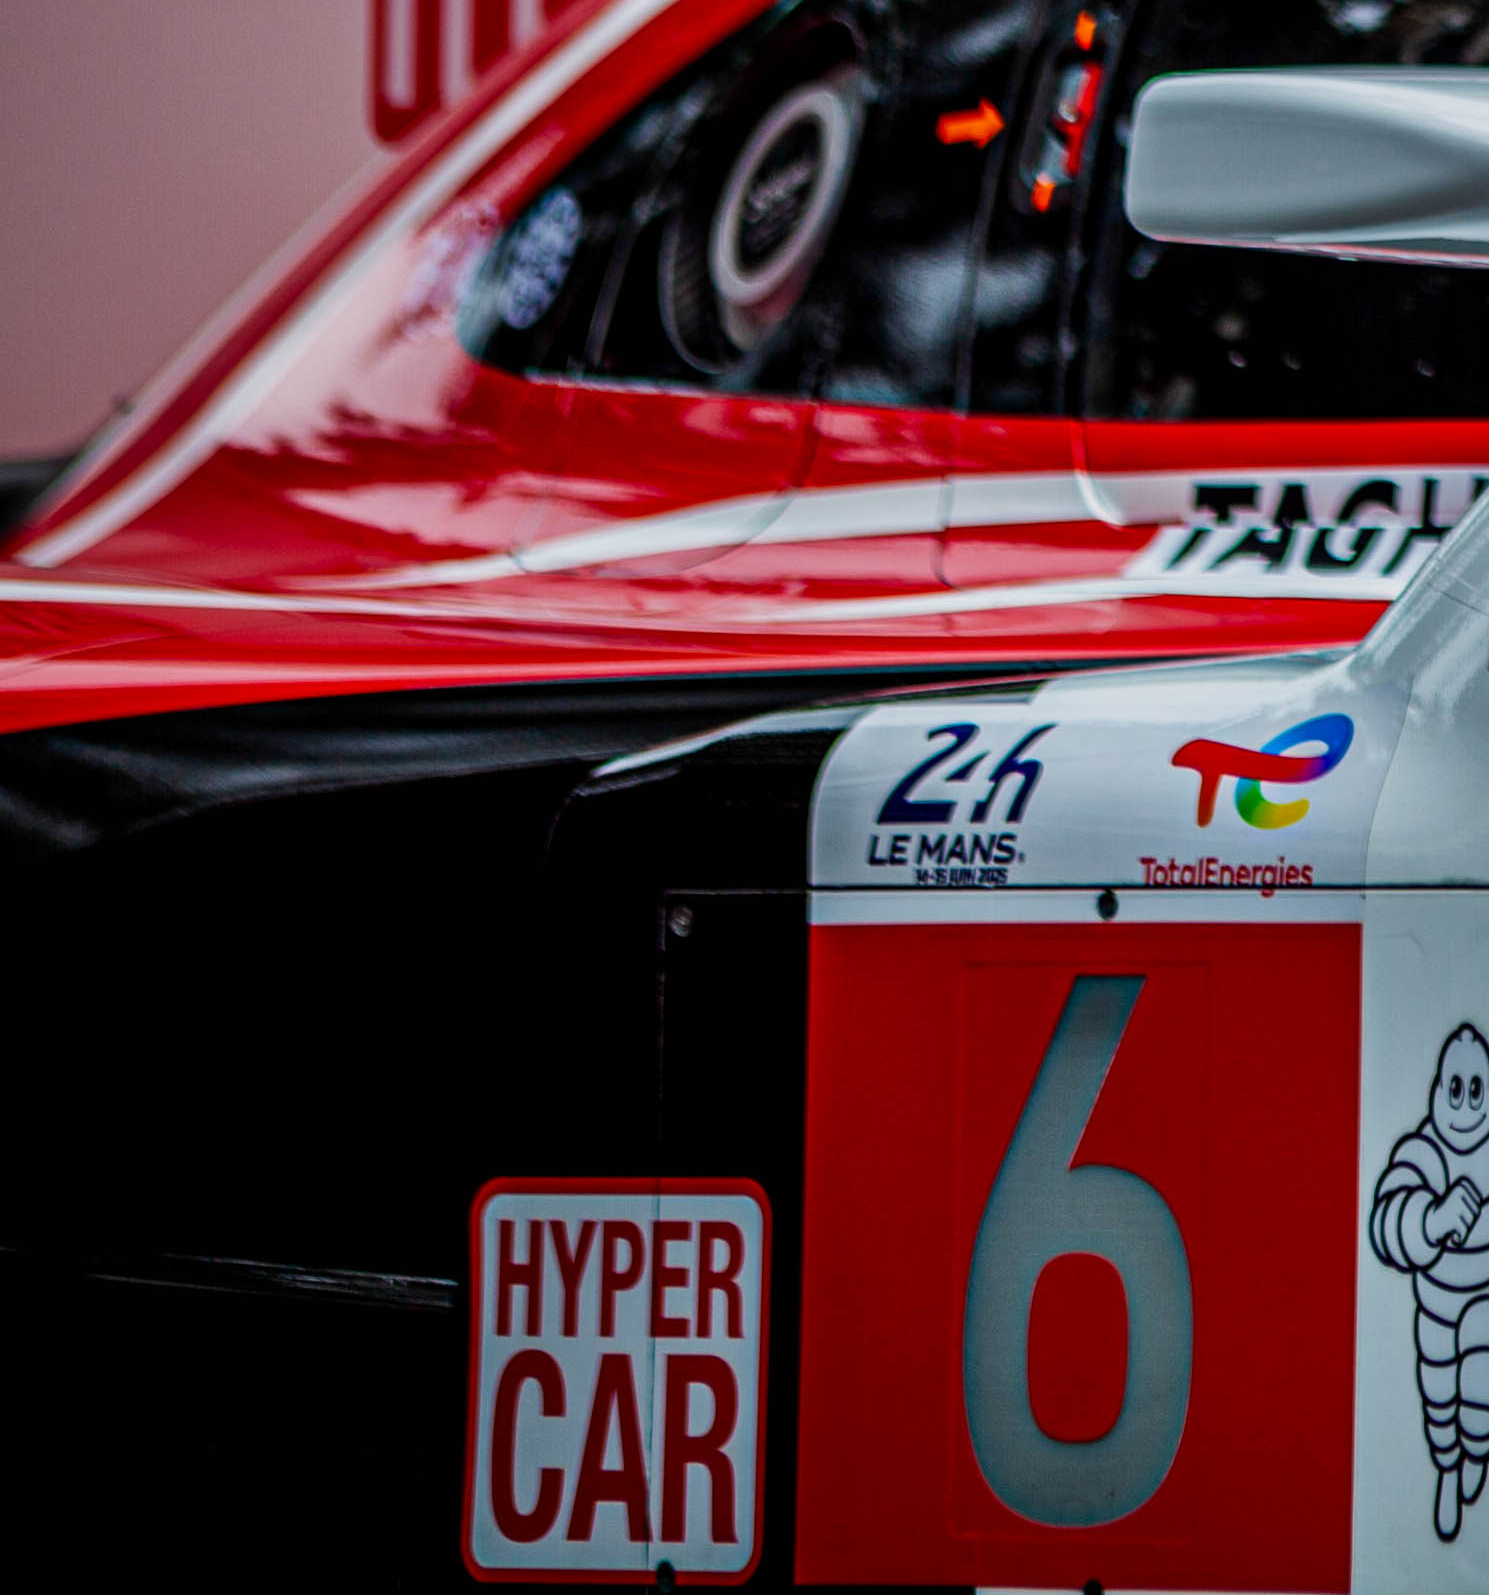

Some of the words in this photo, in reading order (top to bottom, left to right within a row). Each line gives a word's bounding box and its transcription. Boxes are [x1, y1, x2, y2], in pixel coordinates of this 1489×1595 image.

[867, 833, 911, 867] LE
[1138, 855, 1314, 898] TotalEnergies
[494, 1218, 746, 1339] HYPER
[962, 974, 1194, 1529] 6
[490, 1347, 741, 1544] CAR
